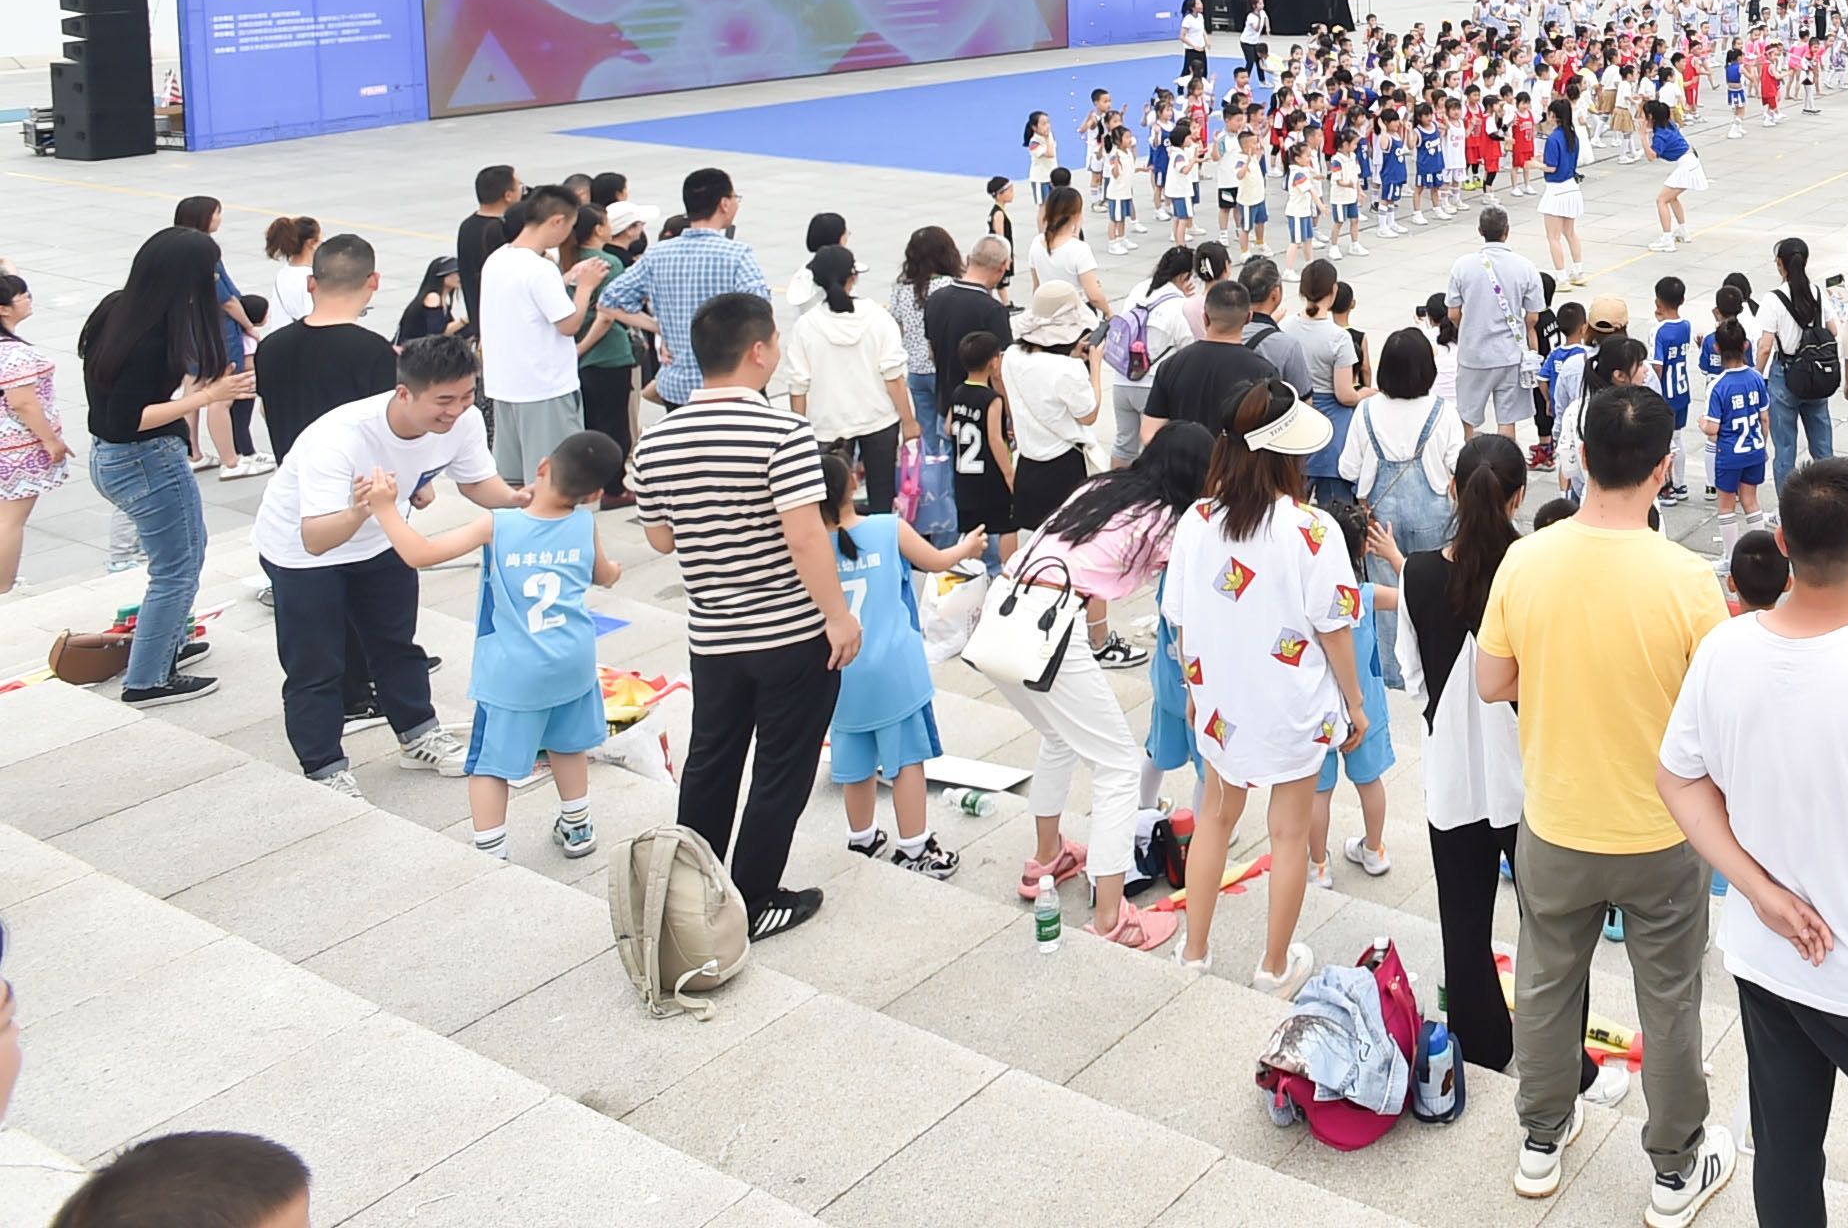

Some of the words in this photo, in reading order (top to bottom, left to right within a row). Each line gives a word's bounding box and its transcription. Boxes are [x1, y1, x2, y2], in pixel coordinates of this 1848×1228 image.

[1665, 360, 1689, 399] 16
[951, 420, 985, 474] 12
[1731, 412, 1766, 454] 23
[505, 548, 581, 568] 尚丰幼儿园
[522, 571, 568, 635] 2
[840, 577, 868, 632] 7
